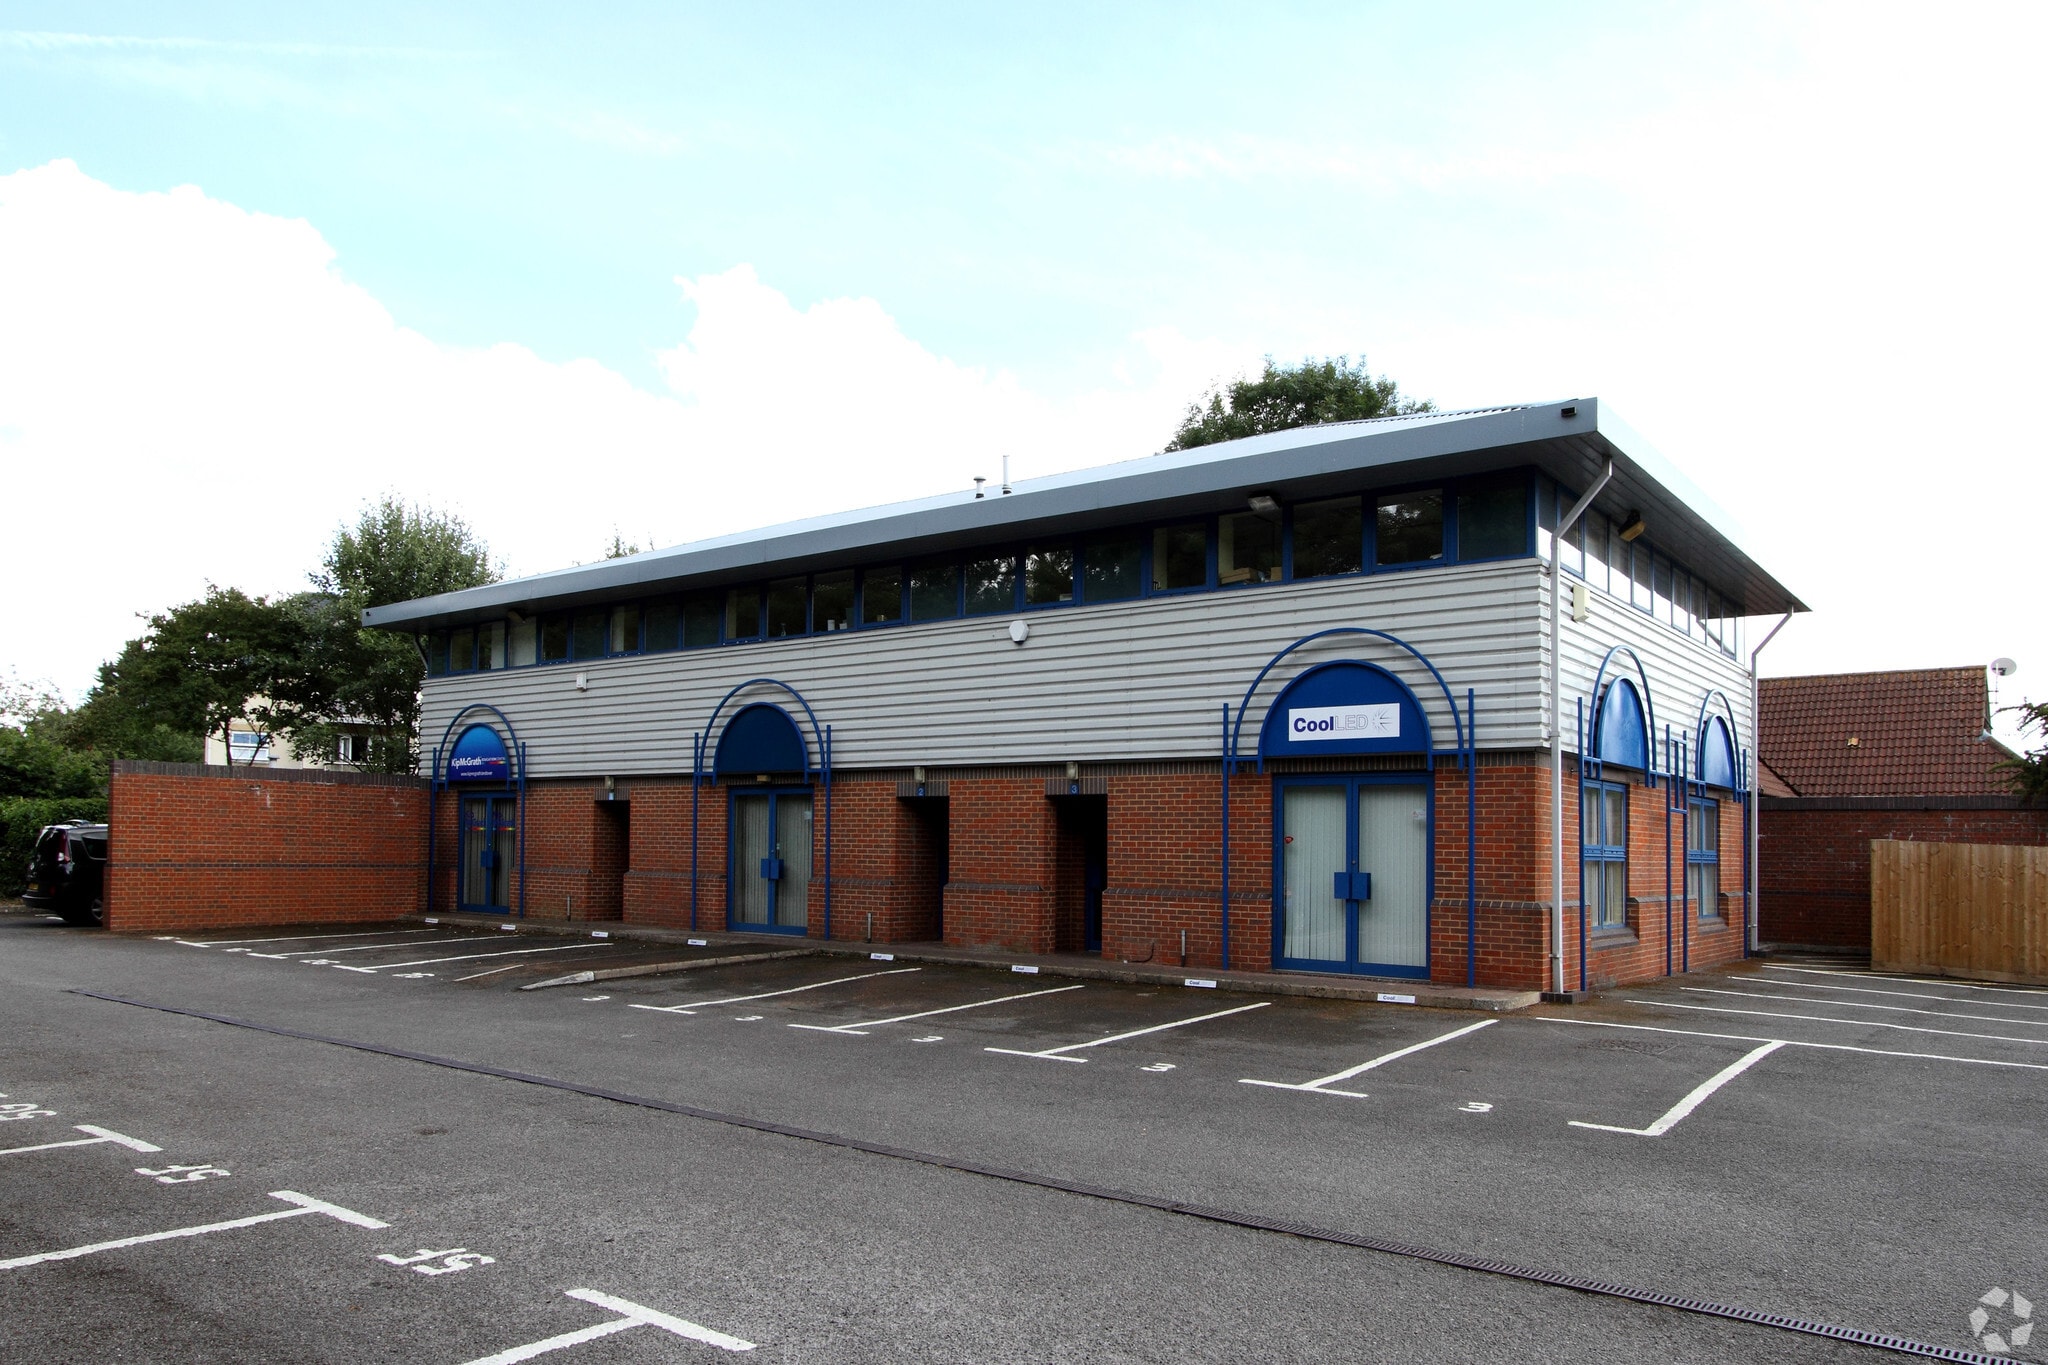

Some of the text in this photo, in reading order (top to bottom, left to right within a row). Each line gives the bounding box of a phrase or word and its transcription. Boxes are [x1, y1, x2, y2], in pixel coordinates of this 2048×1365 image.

[1294, 714, 1368, 732] CoolLED
[451, 756, 481, 769] KipMcGrath
[918, 788, 924, 797] 2
[1071, 785, 1078, 794] 3
[1140, 1063, 1176, 1072] 3
[1458, 1102, 1493, 1112] 3
